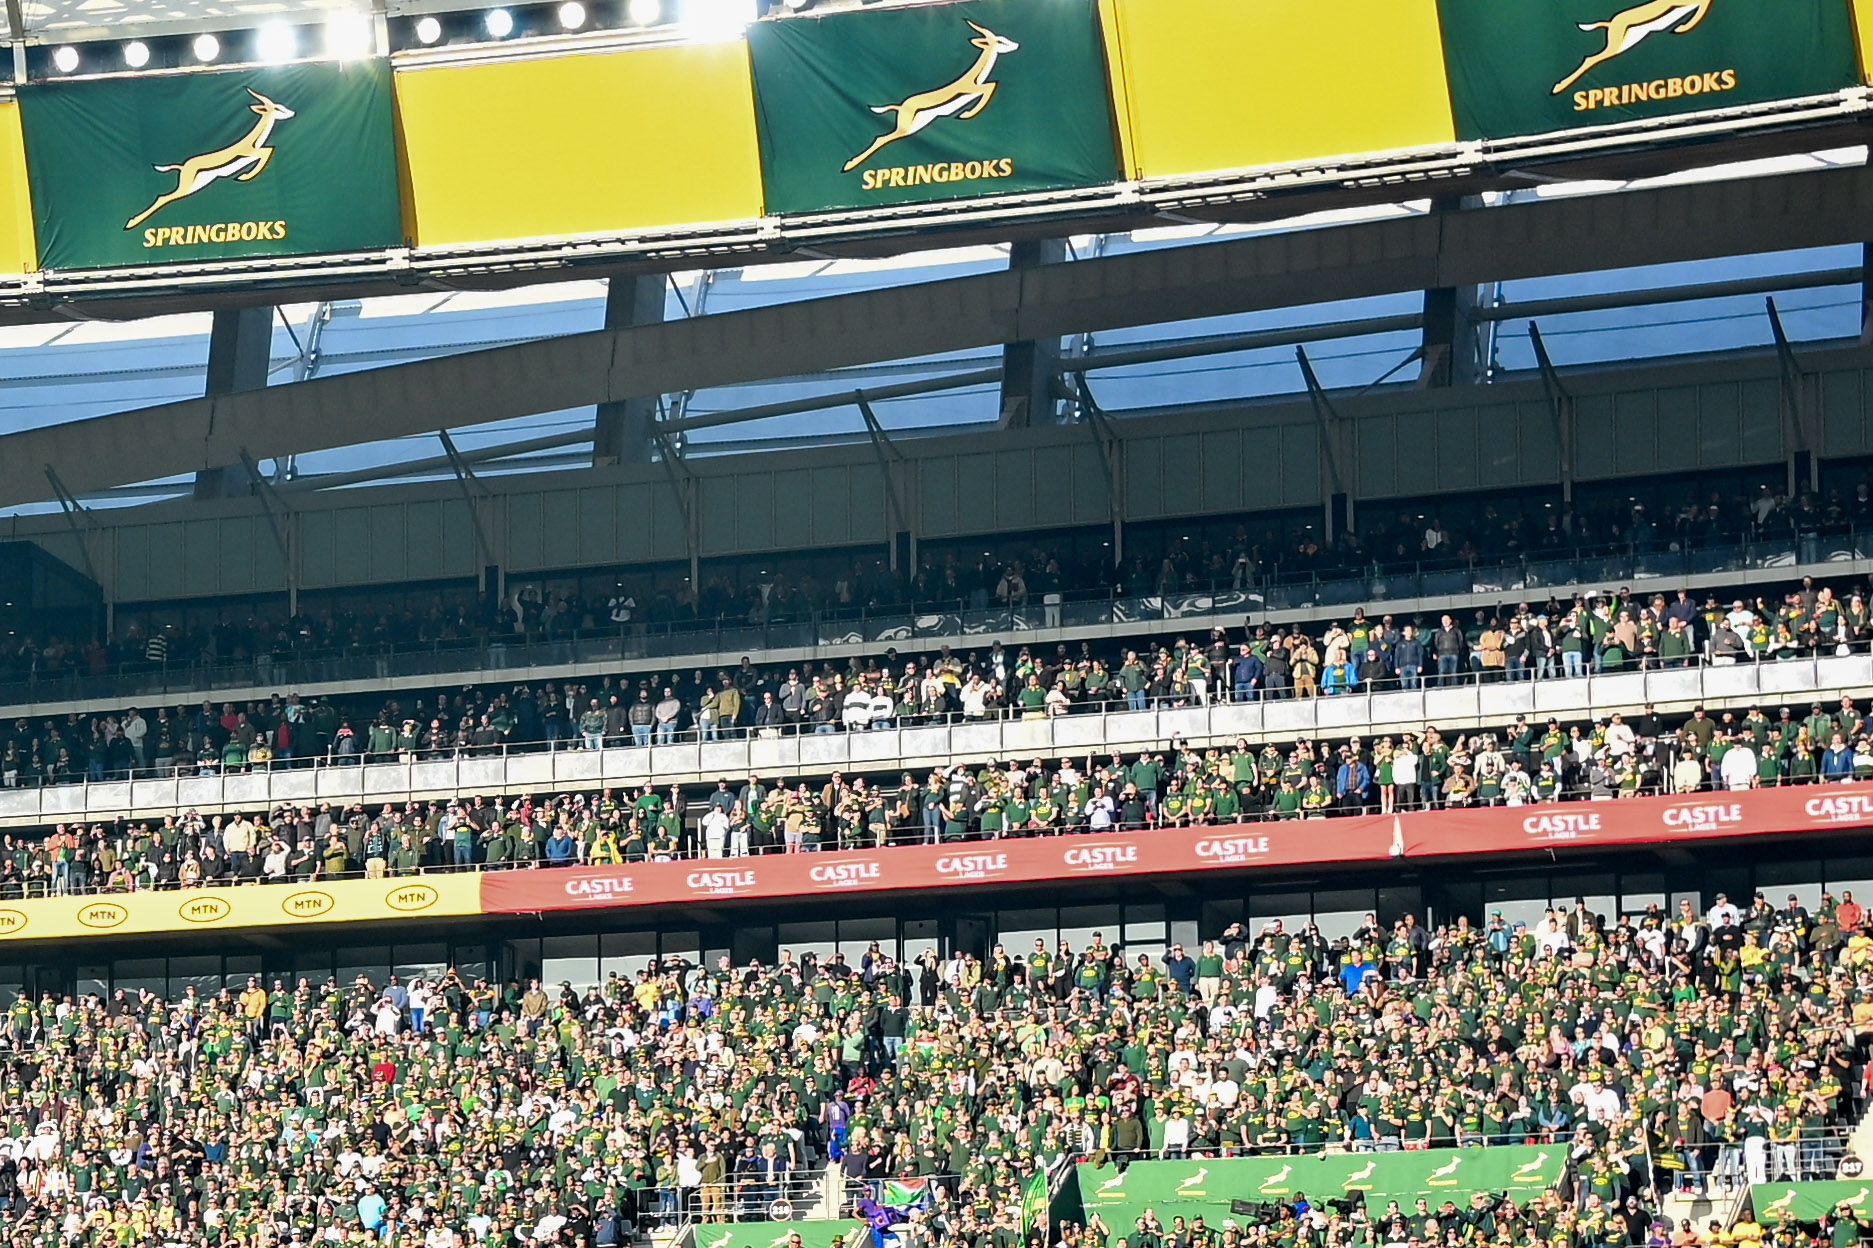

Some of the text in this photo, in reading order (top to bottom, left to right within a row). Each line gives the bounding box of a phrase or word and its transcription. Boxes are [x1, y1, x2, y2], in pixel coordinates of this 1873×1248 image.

[1573, 69, 1736, 111] SPRINGBOKS
[861, 158, 1012, 189] SPRINGBOKS
[143, 221, 286, 247] SPRINGBOKS
[1523, 813, 1601, 833] CASTLE
[1662, 804, 1742, 825] CASTLE
[1064, 846, 1138, 865] CASTLE
[1195, 837, 1270, 857] CASTLE
[810, 862, 880, 882] CASTLE
[935, 853, 1008, 873] CASTLE
[564, 877, 634, 895] CASTLE
[686, 870, 756, 889] CASTLE
[294, 899, 322, 910] MTN
[398, 892, 426, 903] MTN
[89, 910, 116, 921] MTN
[191, 904, 218, 915] MTN
